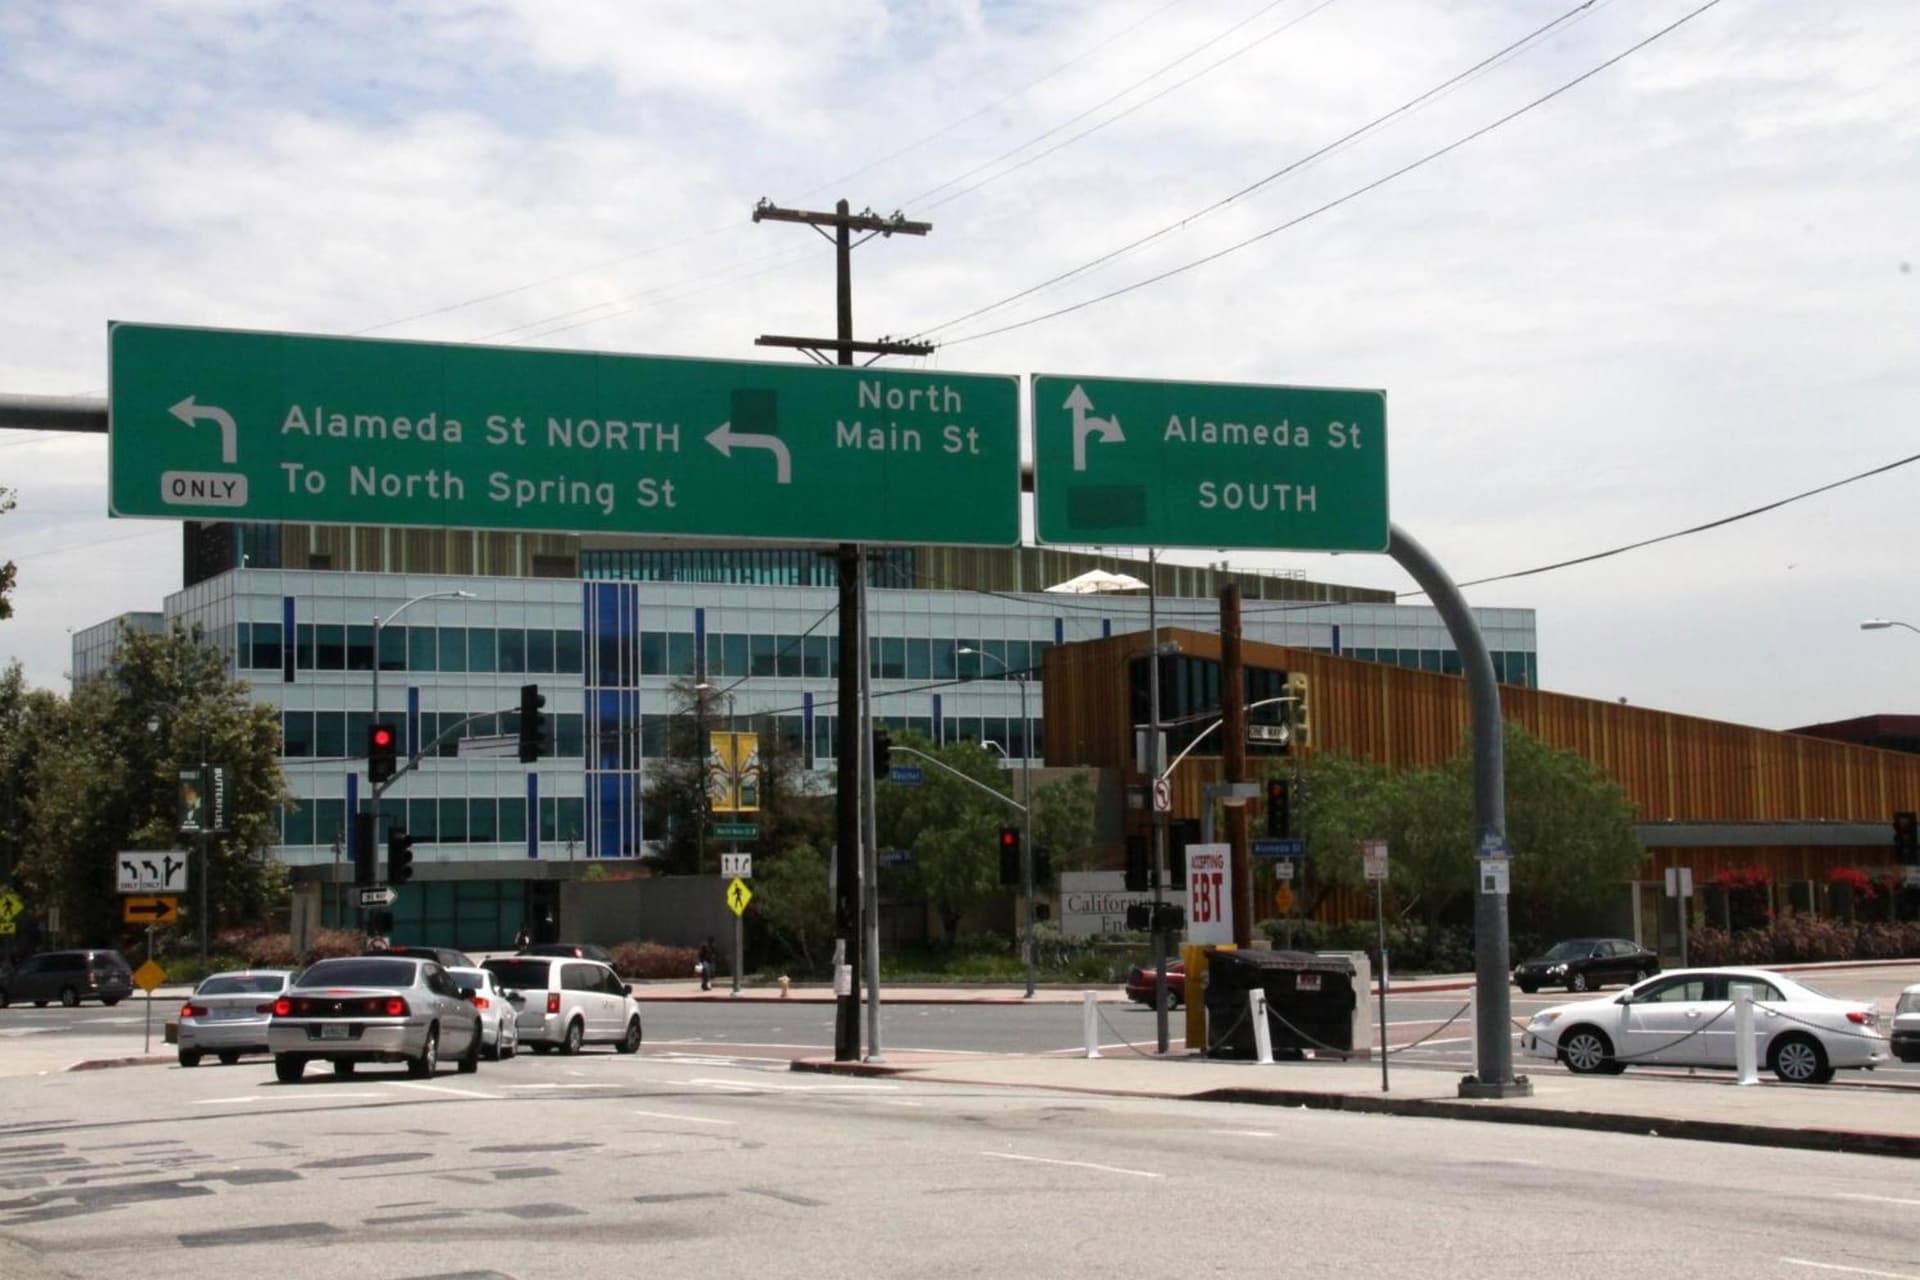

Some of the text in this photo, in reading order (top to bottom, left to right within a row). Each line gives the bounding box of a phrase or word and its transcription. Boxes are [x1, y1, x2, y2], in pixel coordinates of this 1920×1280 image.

[858, 380, 962, 412] North
[281, 404, 680, 452] Alameda St NORTH
[836, 420, 980, 454] Main St
[1164, 415, 1361, 449] Alameda St
[172, 478, 237, 499] ONLY
[280, 462, 677, 515] To North Spring St
[1199, 481, 1317, 511] SOUTH
[1192, 873, 1223, 922] EBT
